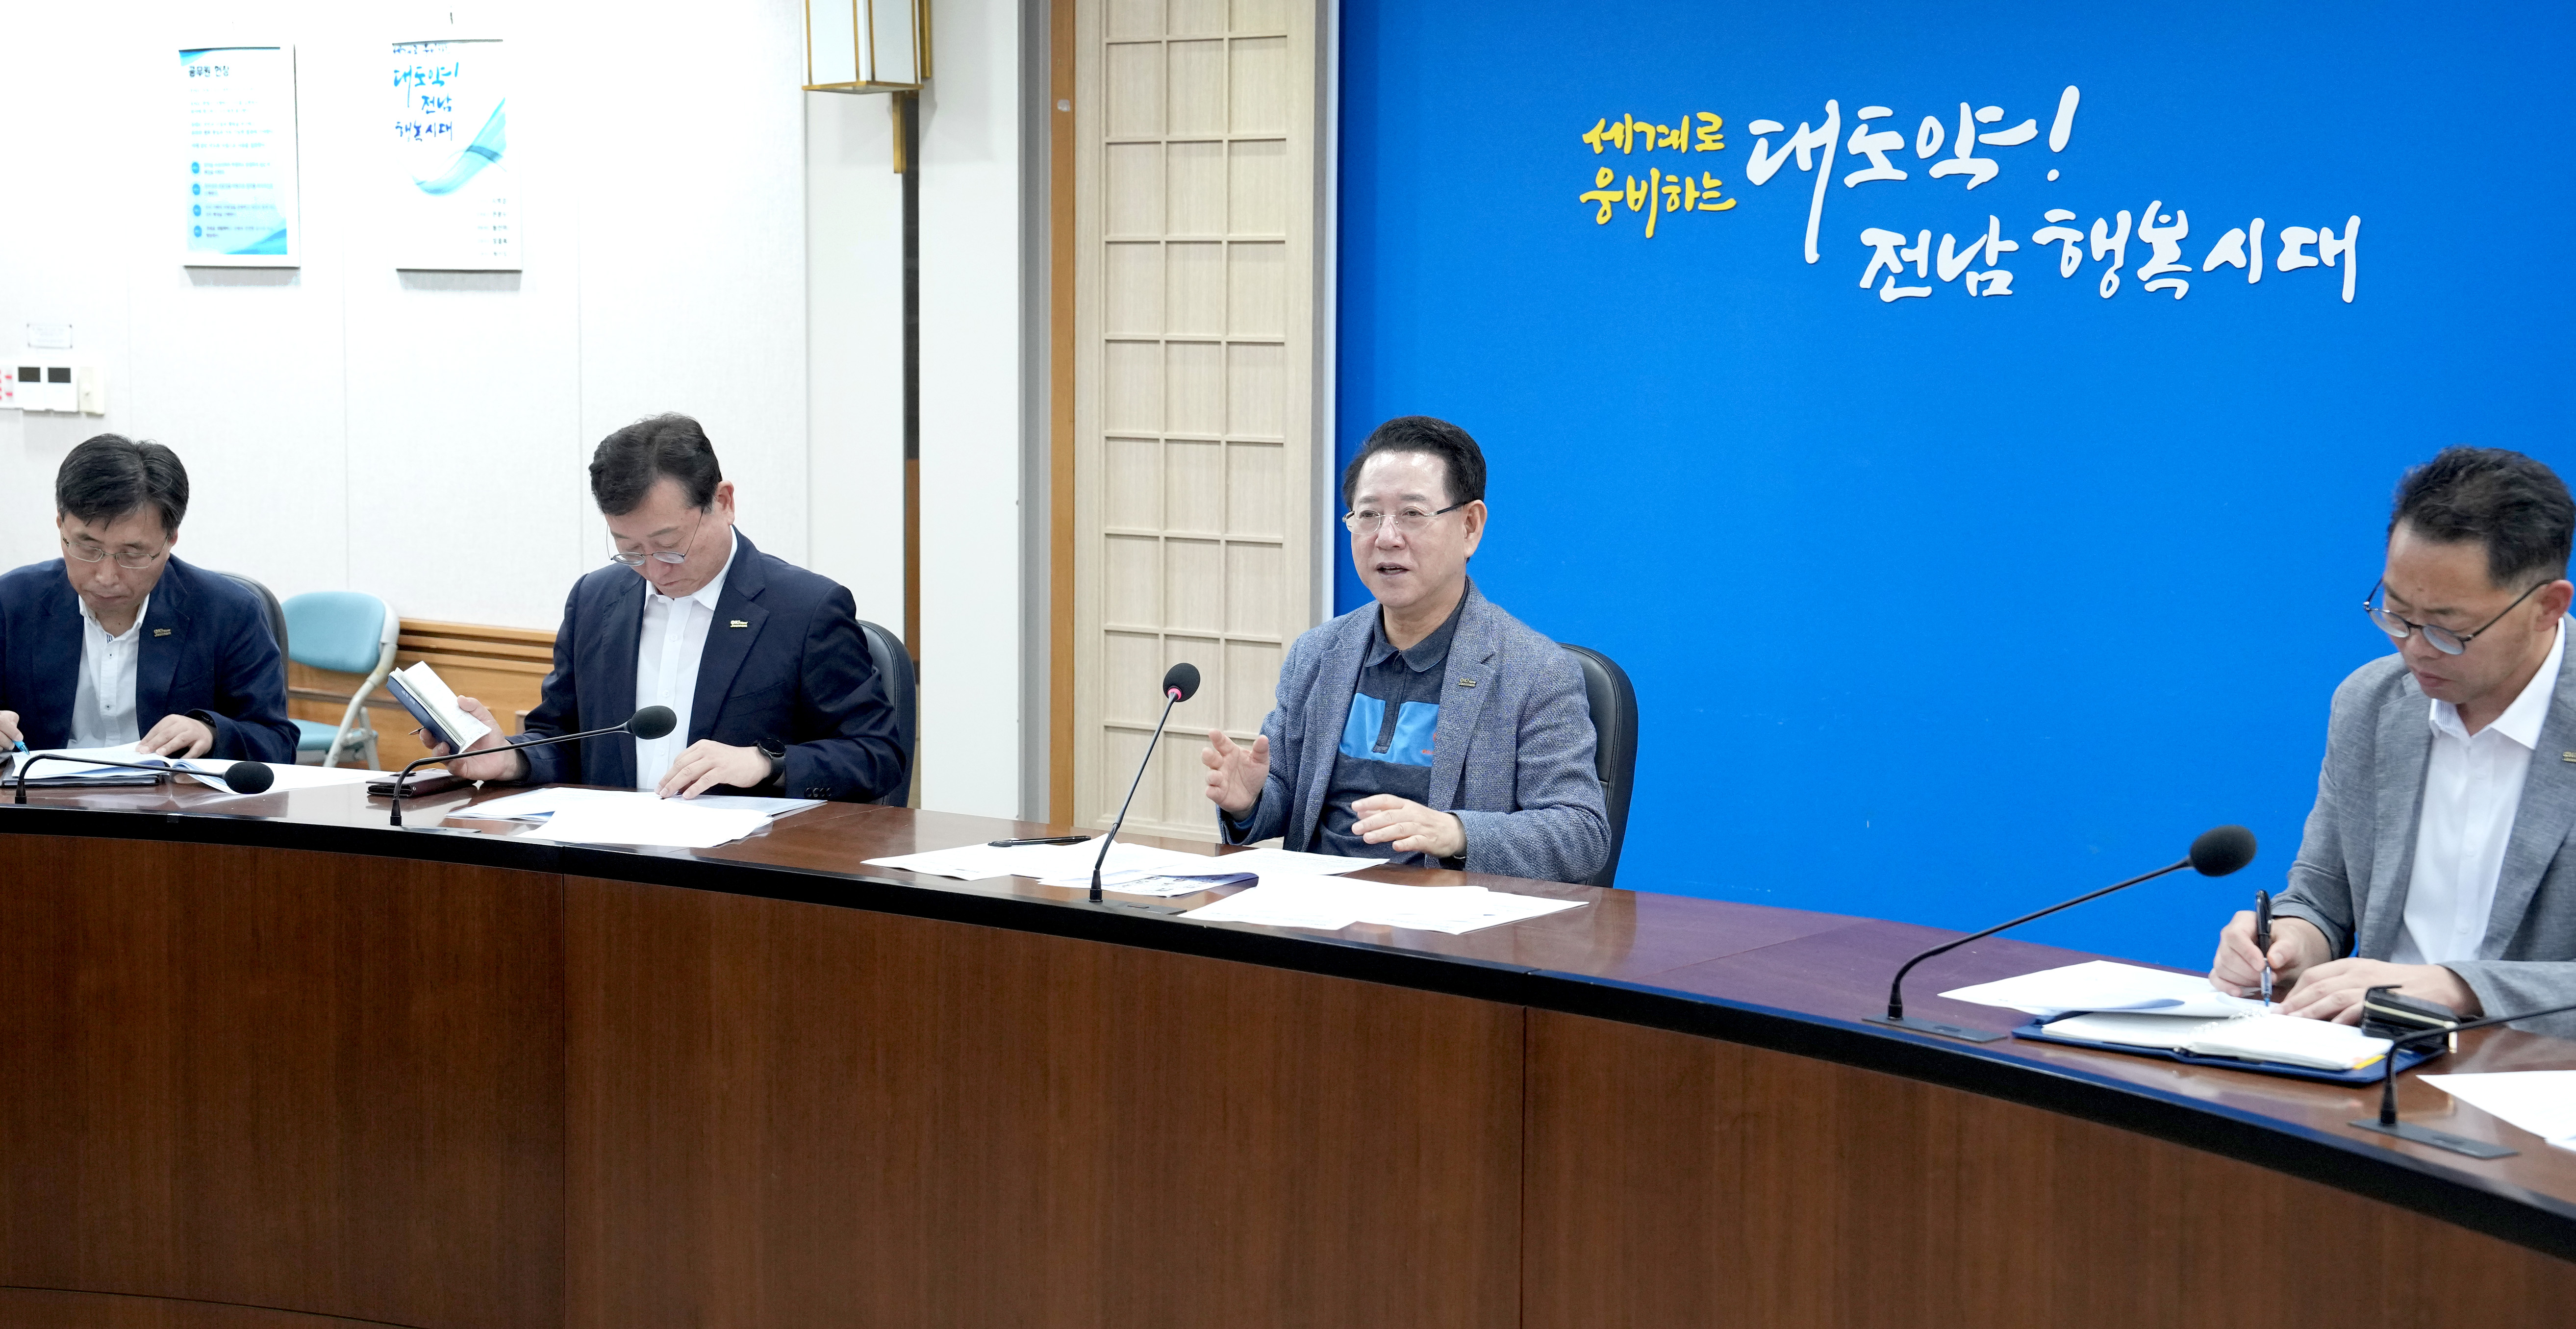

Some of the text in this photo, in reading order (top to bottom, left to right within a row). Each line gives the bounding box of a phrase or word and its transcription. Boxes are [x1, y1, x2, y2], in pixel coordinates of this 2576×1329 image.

[421, 93, 452, 114] 전남
[1582, 112, 1725, 154] 세계로
[1579, 167, 1737, 238] 웅비하는
[1746, 85, 2080, 264] 대도약!
[1859, 215, 2019, 302] 전남
